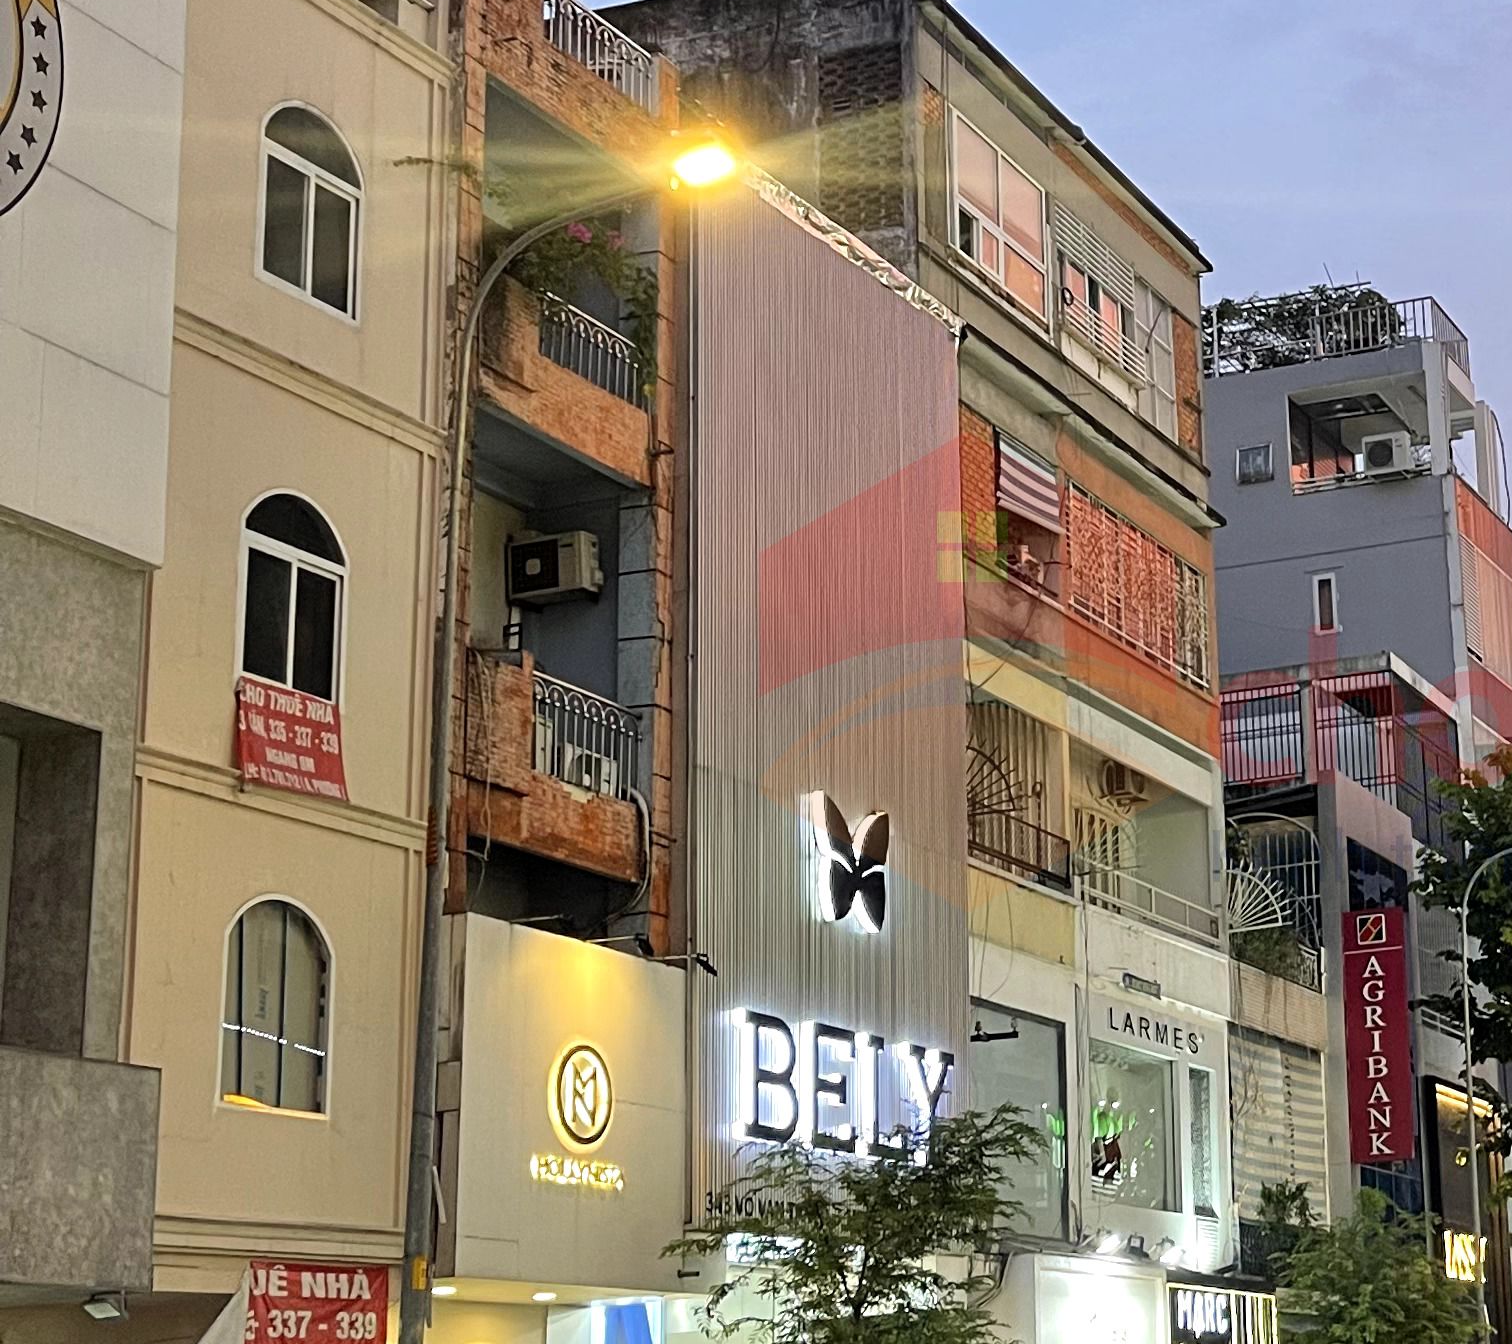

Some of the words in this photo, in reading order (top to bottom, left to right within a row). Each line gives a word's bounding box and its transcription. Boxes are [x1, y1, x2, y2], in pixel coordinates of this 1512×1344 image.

[1108, 1006, 1199, 1054] LARMES
[1361, 955, 1396, 1156] AGRIBANK
[730, 1006, 956, 1168] BELY
[301, 1268, 372, 1300] NHÀ
[267, 1308, 313, 1340] 337
[335, 1311, 377, 1340] 339
[1177, 1289, 1229, 1337] MARC
